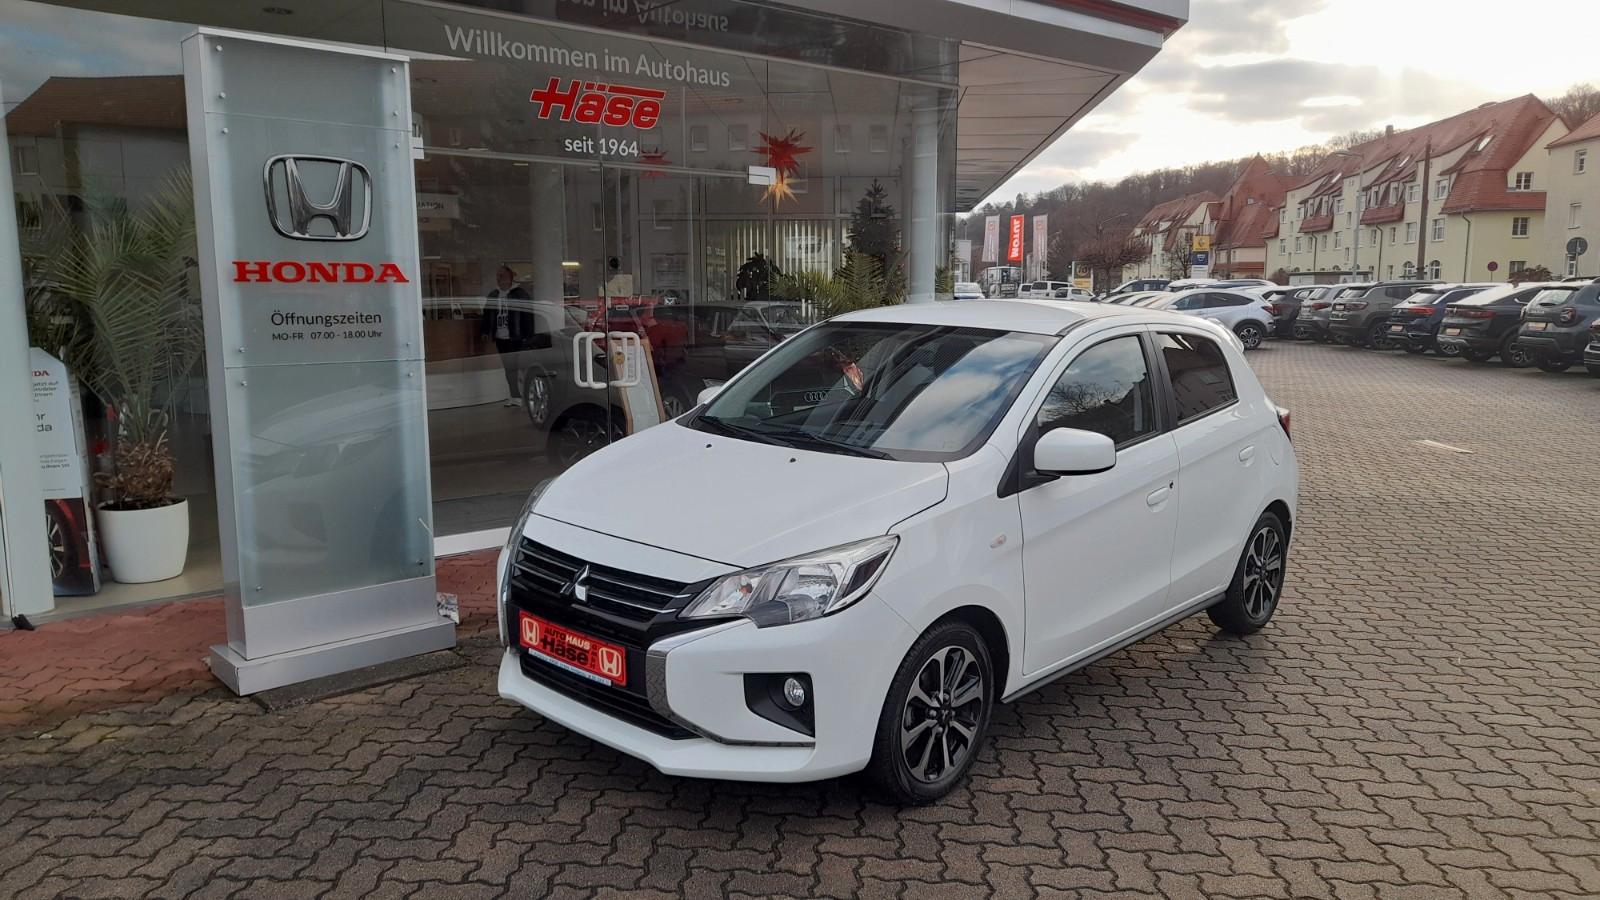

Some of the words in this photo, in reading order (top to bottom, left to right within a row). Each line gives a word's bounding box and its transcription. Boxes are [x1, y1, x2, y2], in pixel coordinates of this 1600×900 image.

[445, 24, 598, 69] Willkommen
[604, 49, 630, 74] im
[635, 54, 730, 87] Autohaus
[530, 76, 666, 129] Häse
[564, 136, 594, 154] seit
[599, 137, 639, 158] 1964
[232, 261, 410, 283] HONDA
[271, 309, 382, 327] Öffnungszeiten
[272, 332, 304, 341] MO-FR
[367, 330, 382, 338] Uhr
[541, 634, 590, 666] Häse
[544, 627, 591, 651] AUTOHAUS
